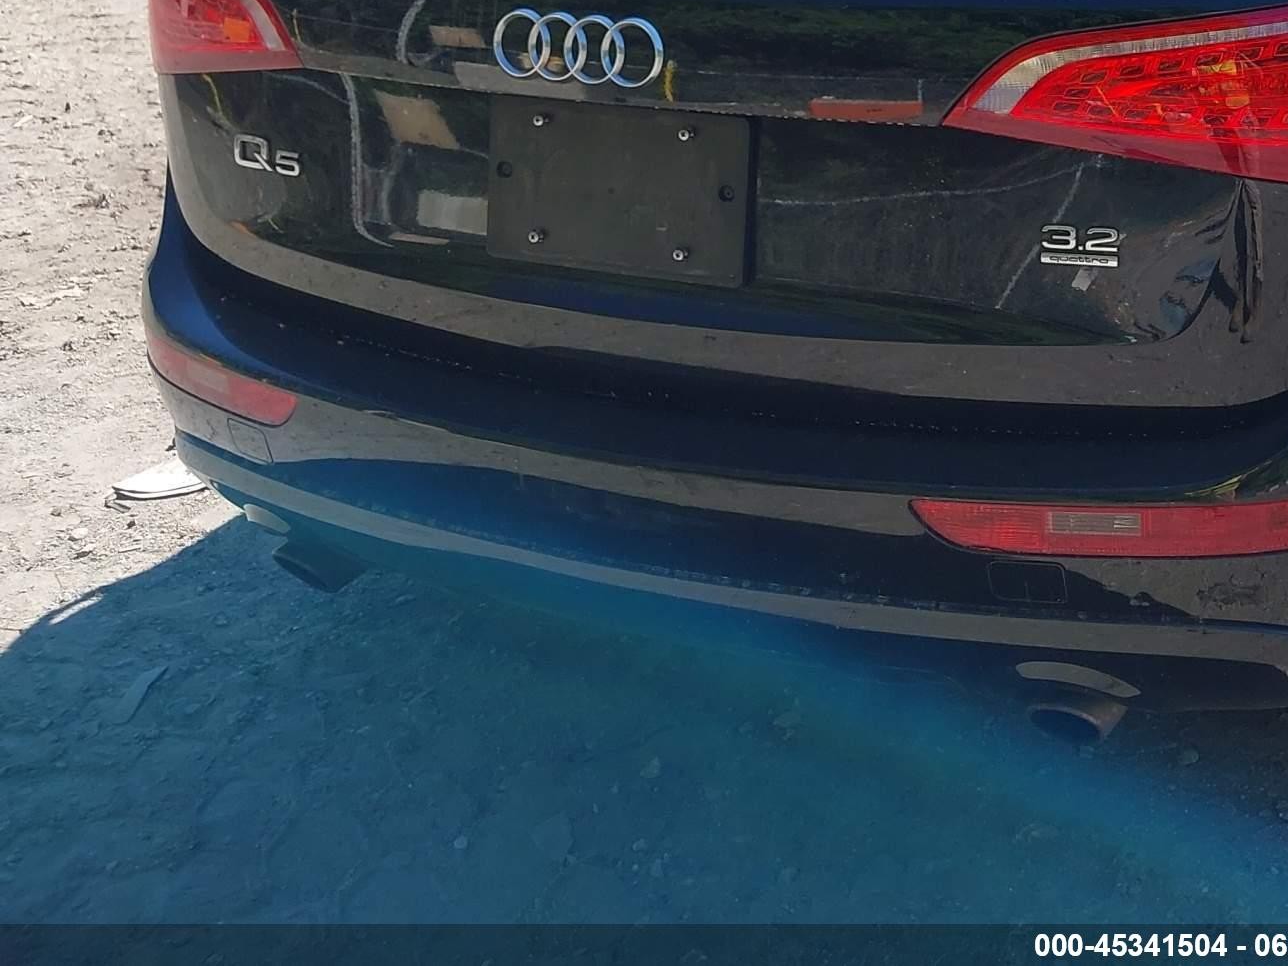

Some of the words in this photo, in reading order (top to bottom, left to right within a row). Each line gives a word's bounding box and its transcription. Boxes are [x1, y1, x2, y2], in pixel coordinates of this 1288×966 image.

[233, 134, 300, 176] Q5
[1041, 225, 1118, 252] 3.2
[1049, 256, 1109, 264] quattro
